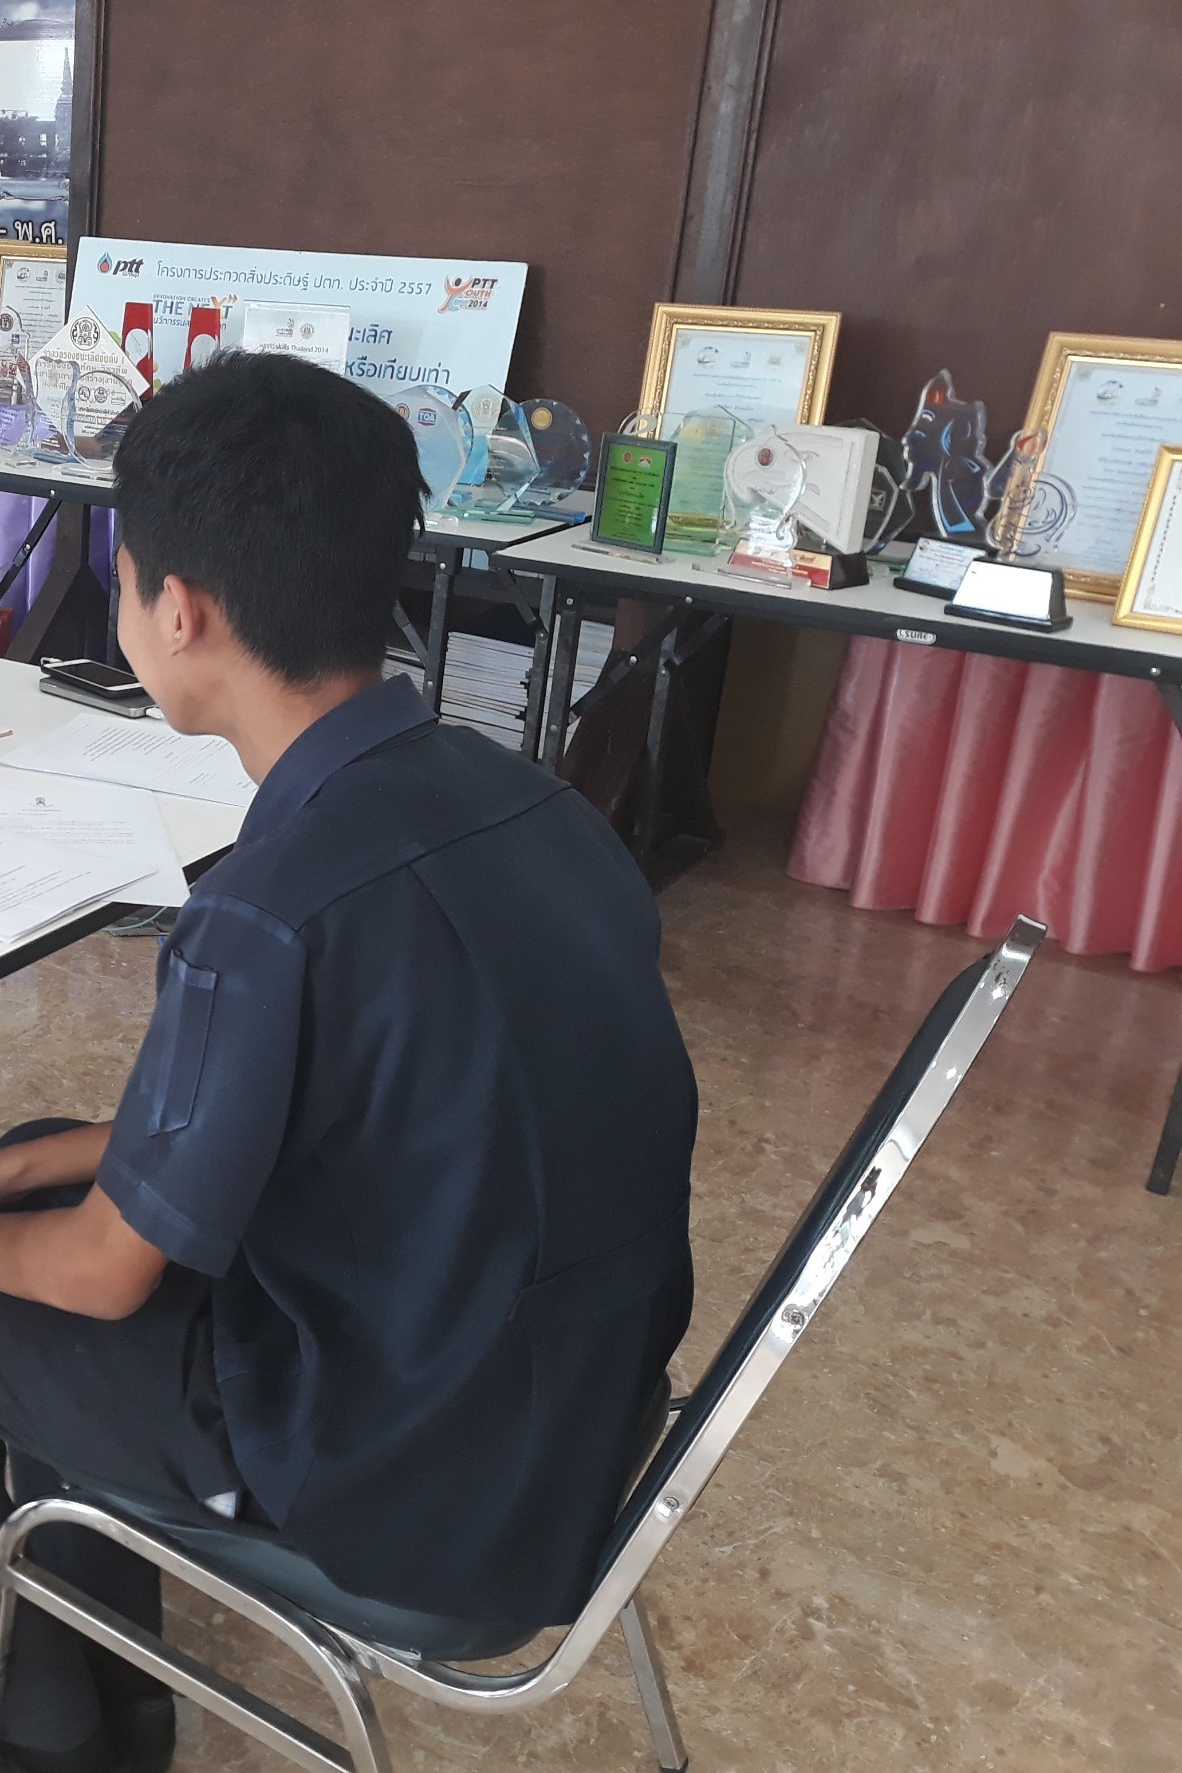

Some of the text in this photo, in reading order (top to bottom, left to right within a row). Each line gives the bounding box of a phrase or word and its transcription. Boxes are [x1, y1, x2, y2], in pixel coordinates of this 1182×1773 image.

[14, 220, 64, 245] พ.ศ.
[113, 257, 144, 275] ptt
[156, 260, 433, 296] โครงการประกวดสิ่งประดิษฐ์ ปตท. ประจำปี 2557
[470, 277, 498, 290] PTT
[153, 299, 184, 316] THE
[468, 298, 489, 309] 2014
[419, 411, 436, 424] TOA
